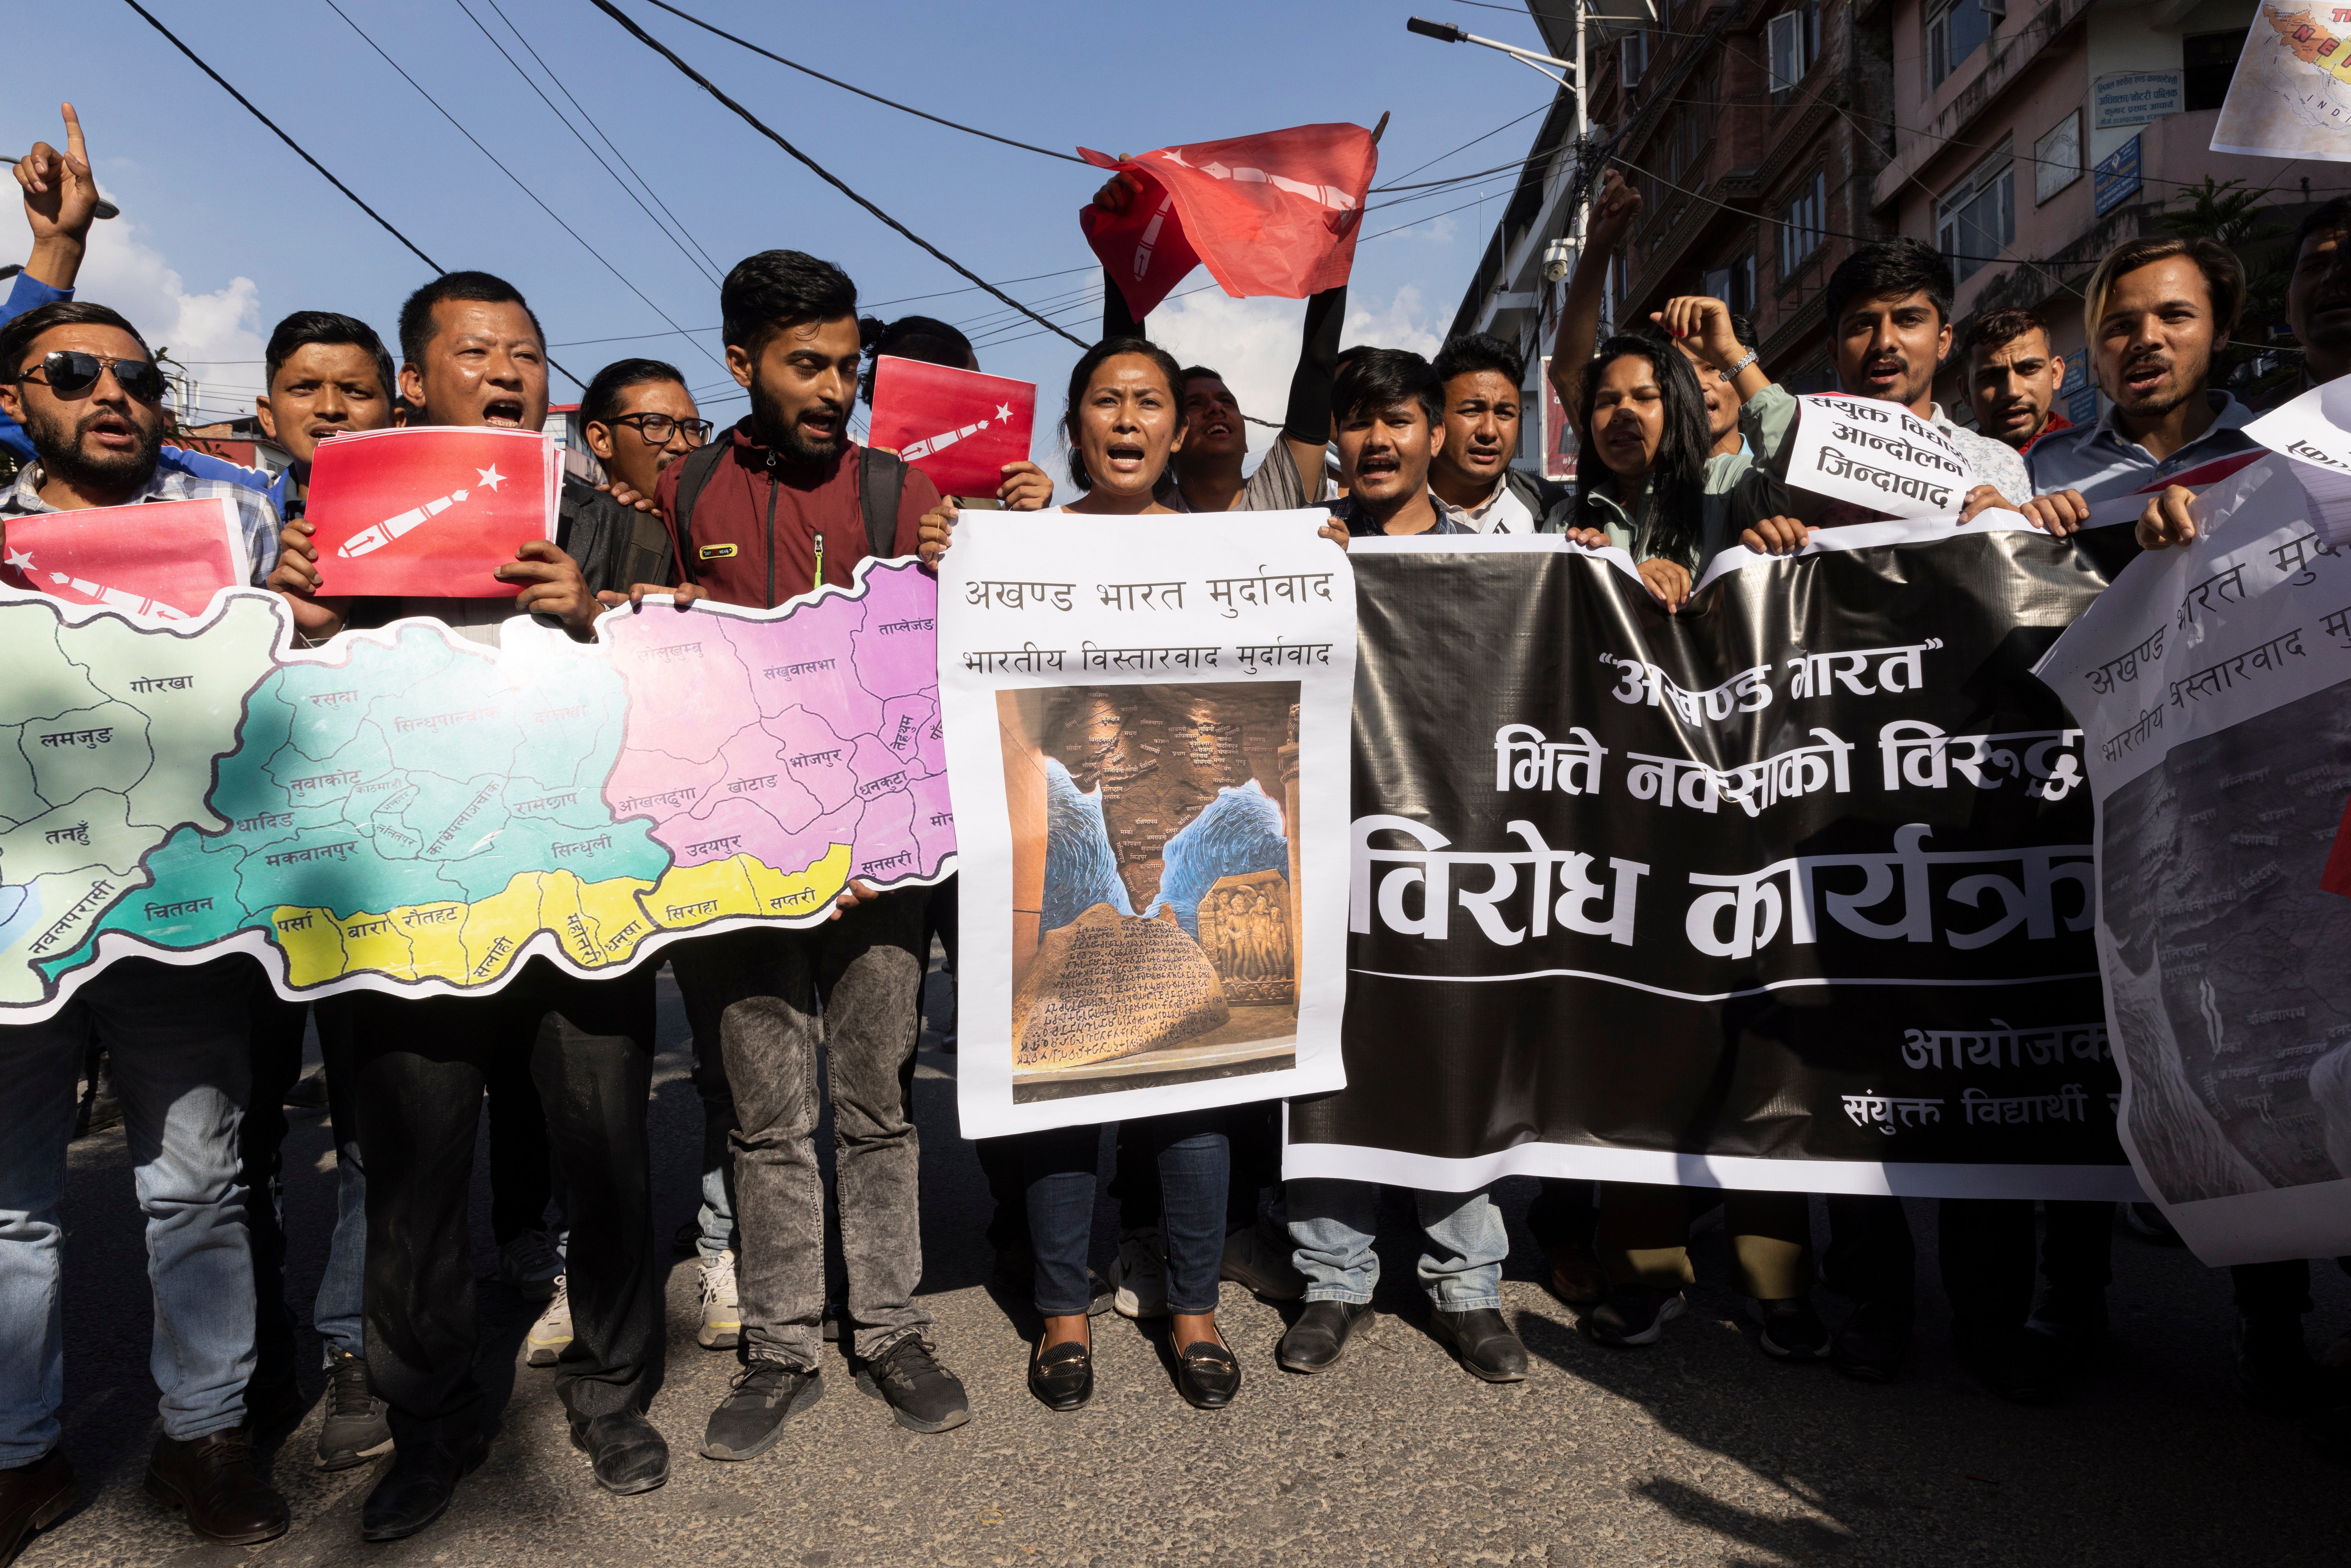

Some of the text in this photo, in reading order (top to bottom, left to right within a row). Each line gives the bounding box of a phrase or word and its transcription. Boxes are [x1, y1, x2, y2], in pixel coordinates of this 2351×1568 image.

[2105, 107, 2125, 116] कुमार
[2128, 105, 2147, 113] प्रसाद
[1806, 396, 1892, 424] संयुक्त
[1832, 422, 1963, 477] आन्दोलन
[1817, 446, 1954, 509] जिन्दावाद
[965, 564, 1334, 619] अखण्ड भारत मुर्दावाद
[2085, 624, 2167, 695] अखण्ड
[2177, 563, 2246, 630] भारत
[963, 636, 1333, 675] भारतीय विस्तारवाद मुर्दावाद
[763, 657, 836, 681] संखुवासभा
[130, 675, 194, 693] गोरखा
[309, 690, 359, 710] रसुवा
[40, 727, 114, 749] लमजुङ
[2102, 704, 2165, 762] भारतीय
[789, 748, 842, 768] भोजपुर
[290, 770, 362, 797] नुवाकोट
[858, 770, 909, 798] धनकुटा
[1627, 727, 1855, 818] नक्साको
[513, 792, 577, 815] रामेछाप
[45, 820, 91, 846] तनहुँ
[265, 840, 359, 867] मकवानपुर
[551, 835, 612, 859] सिन्धुली
[685, 835, 743, 858] उदयपुर
[861, 850, 913, 875] सुनसरी
[769, 887, 816, 910] सप्तरी
[1349, 814, 2096, 961] विरोध कार्यक्र
[28, 879, 116, 954] नवलपरासी
[144, 897, 214, 921] चितवन
[402, 905, 458, 928] रौतहट
[666, 898, 718, 922] सिराहा
[277, 911, 313, 933] पर्सा
[347, 919, 388, 939] बारा
[604, 920, 642, 951] धनुषा
[1841, 1088, 1945, 1136] संयुक्त
[1960, 1084, 2089, 1127] विद्यार्थी
